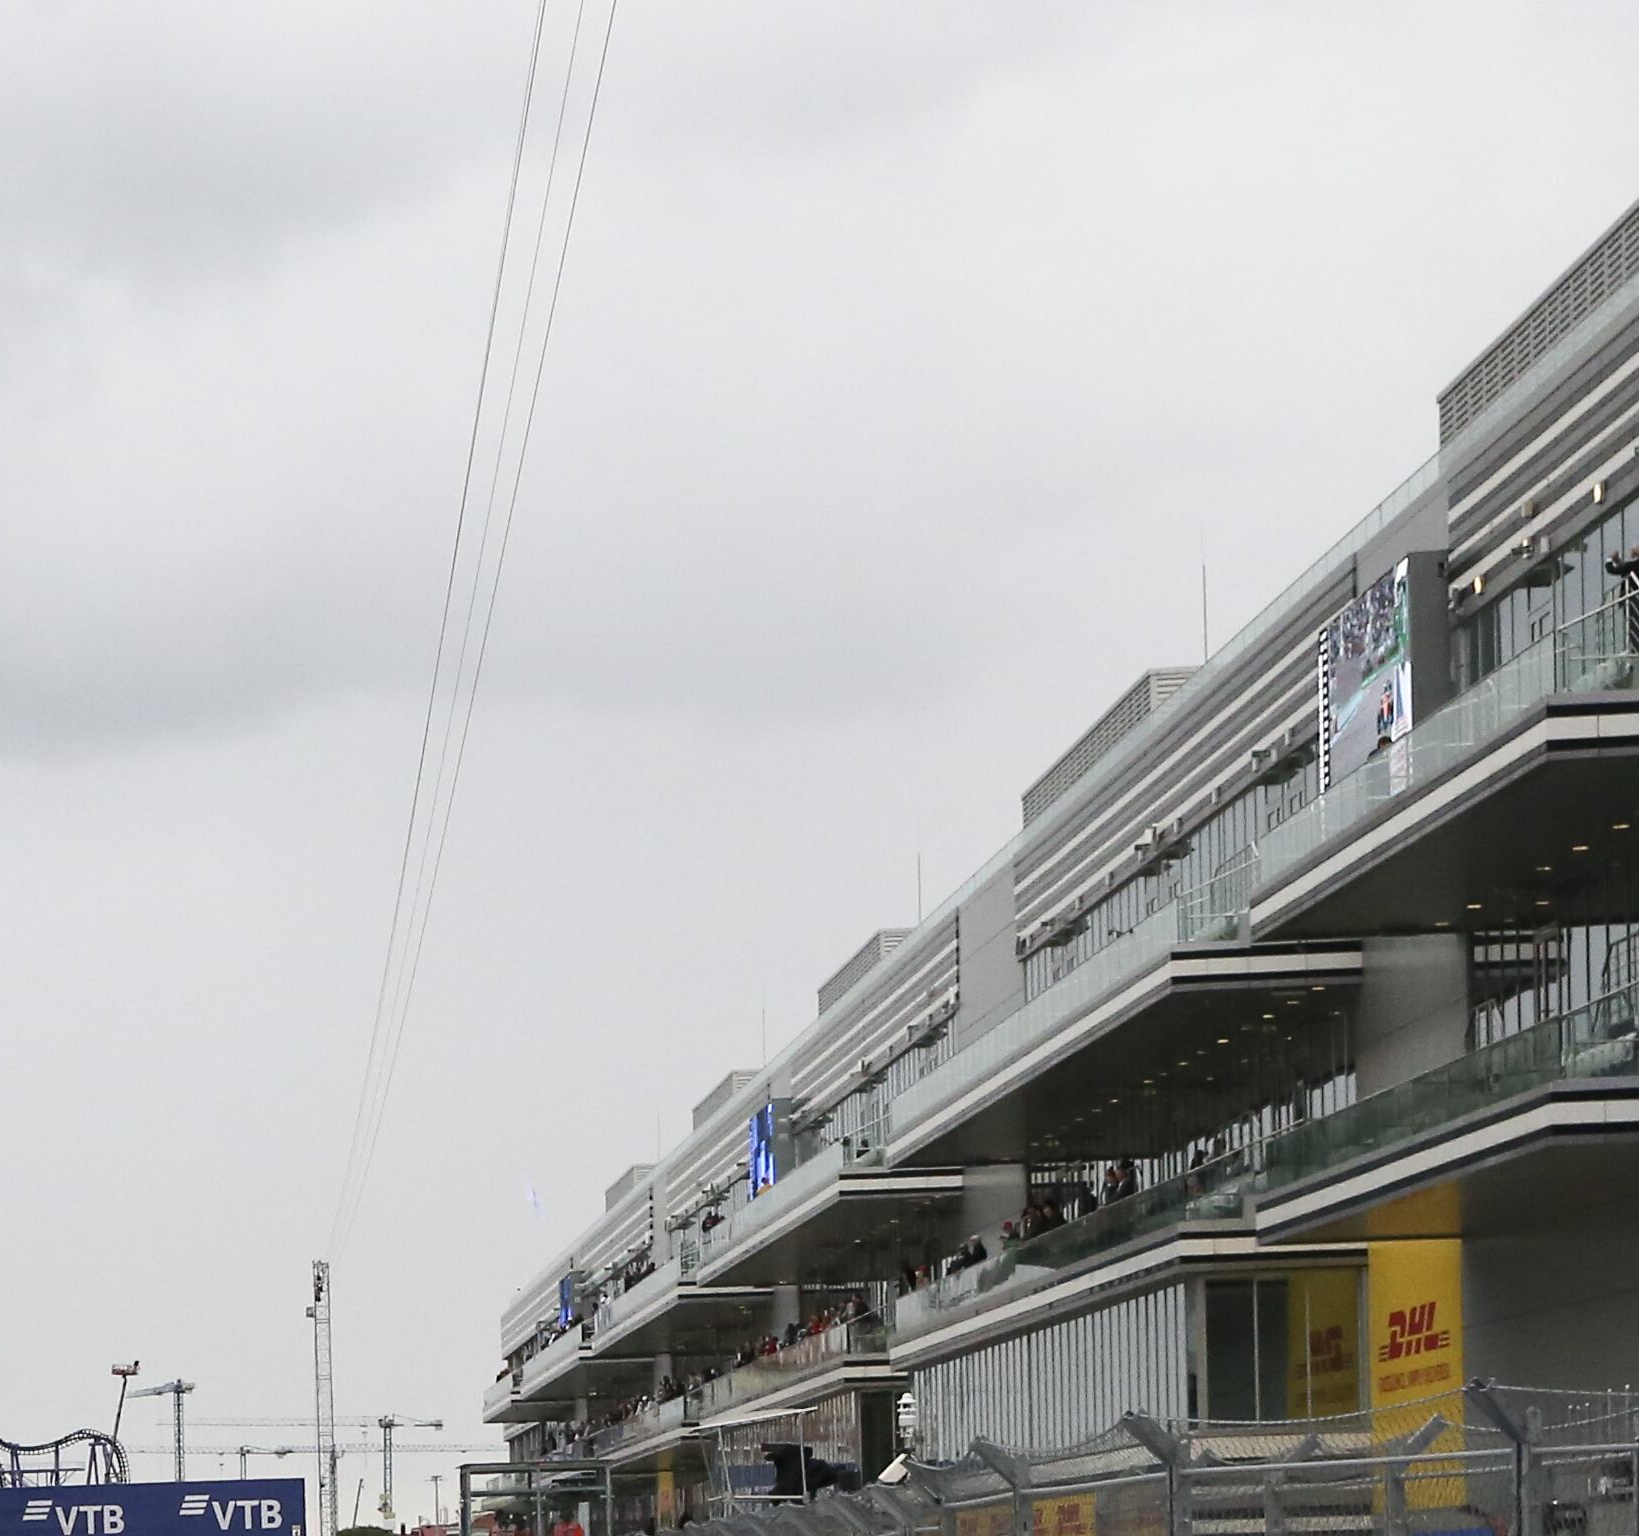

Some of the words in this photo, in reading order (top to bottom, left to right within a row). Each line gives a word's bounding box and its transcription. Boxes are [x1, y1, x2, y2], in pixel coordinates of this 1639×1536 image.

[1387, 1301, 1441, 1360] DHL
[55, 1504, 125, 1536] VTB
[211, 1498, 284, 1530] VTB
